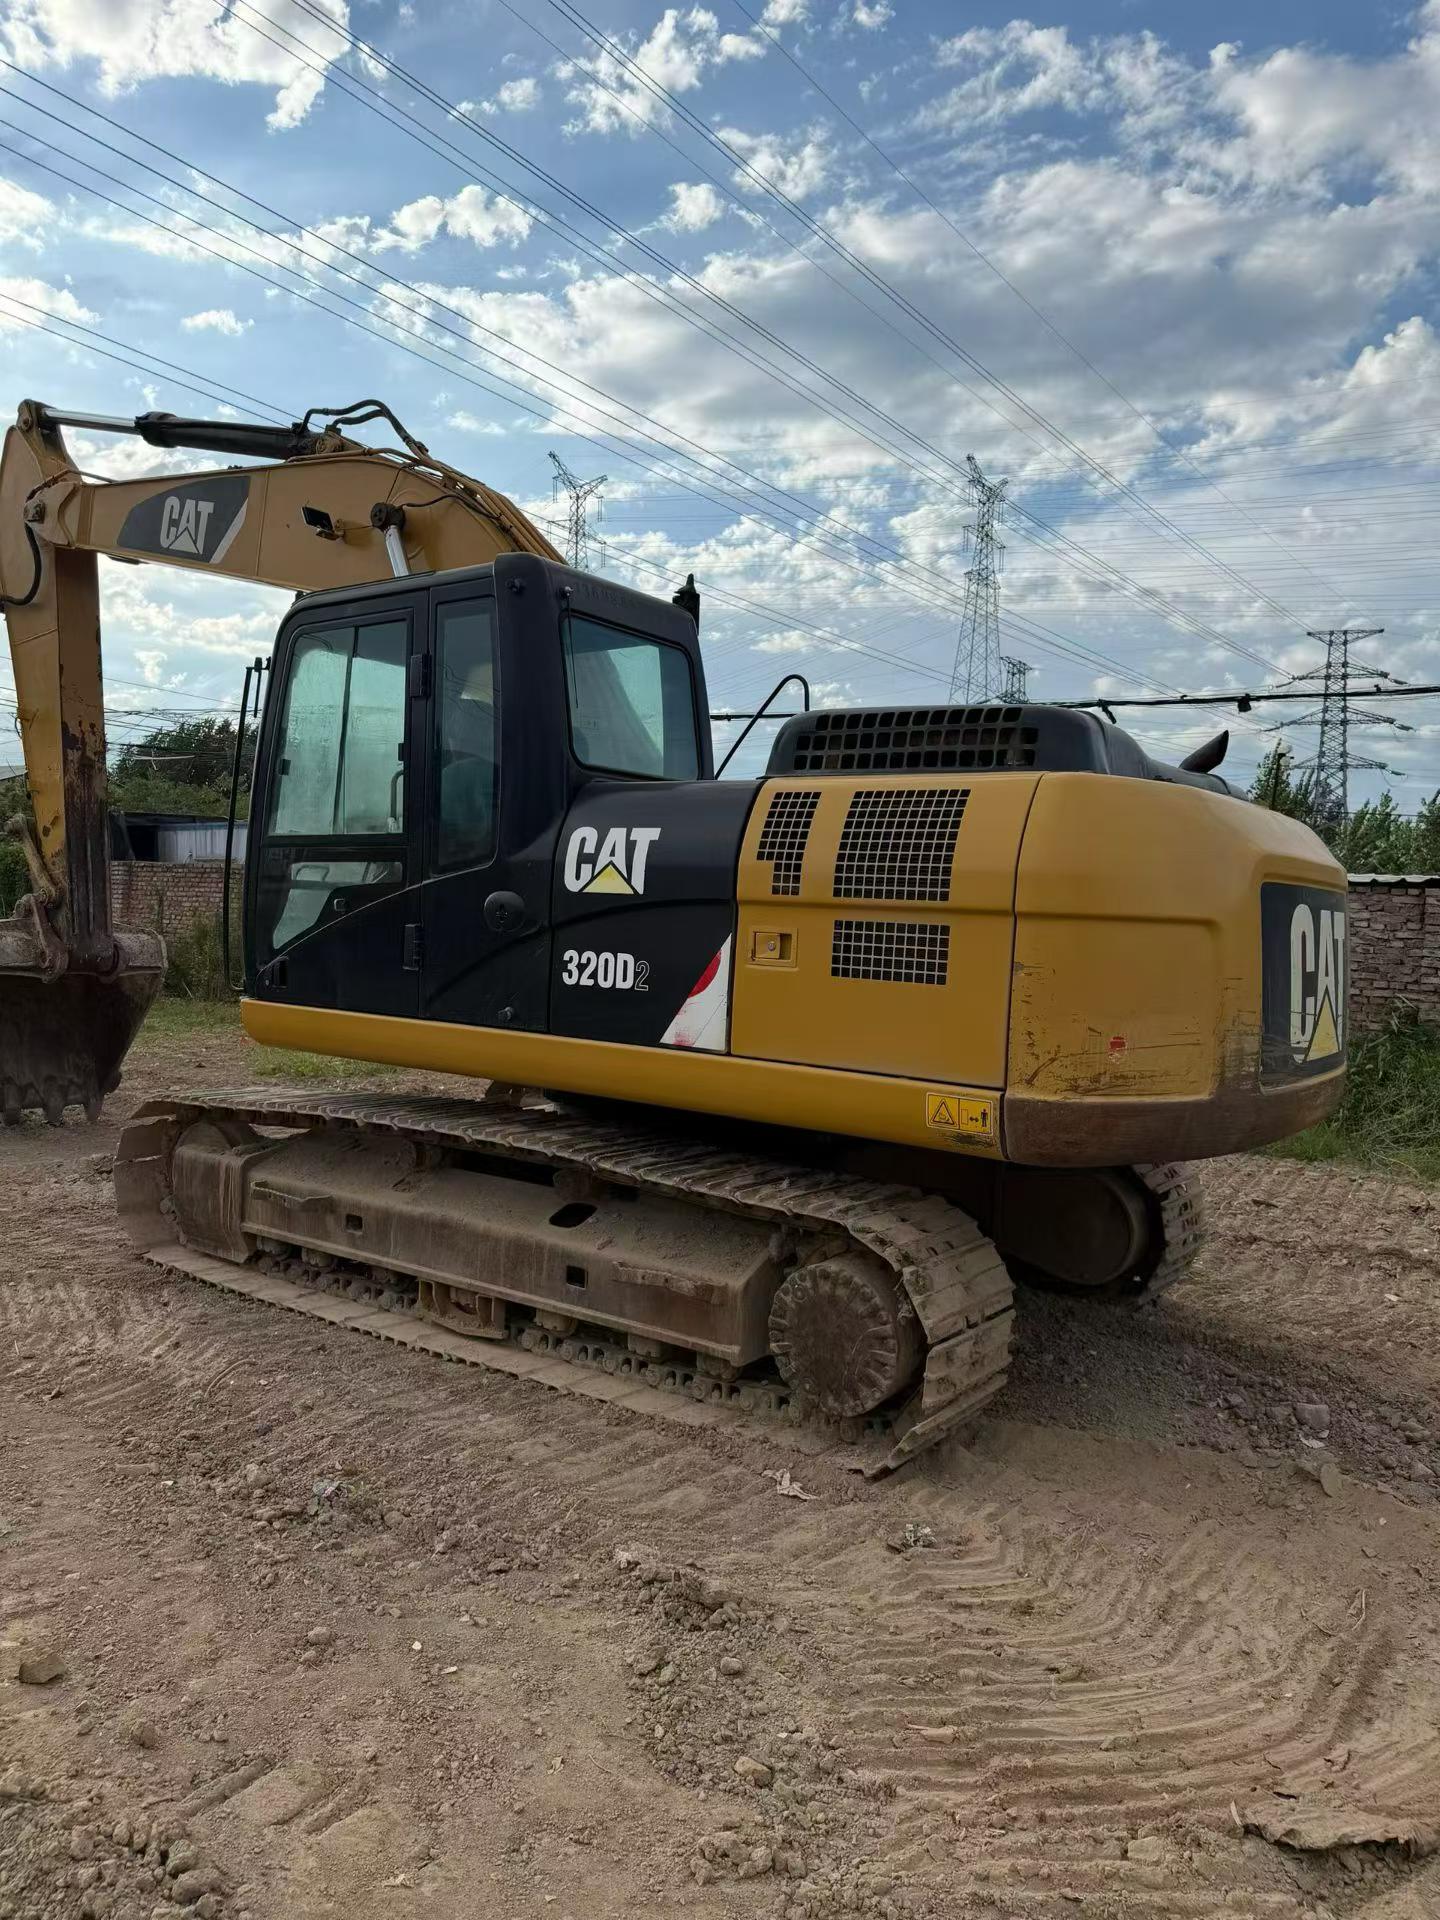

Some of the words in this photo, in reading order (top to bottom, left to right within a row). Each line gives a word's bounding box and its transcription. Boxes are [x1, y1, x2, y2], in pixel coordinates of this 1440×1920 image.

[160, 496, 215, 554] CAT
[564, 826, 661, 895] CAT
[562, 949, 650, 991] 320D2
[1290, 903, 1345, 1064] CAT
